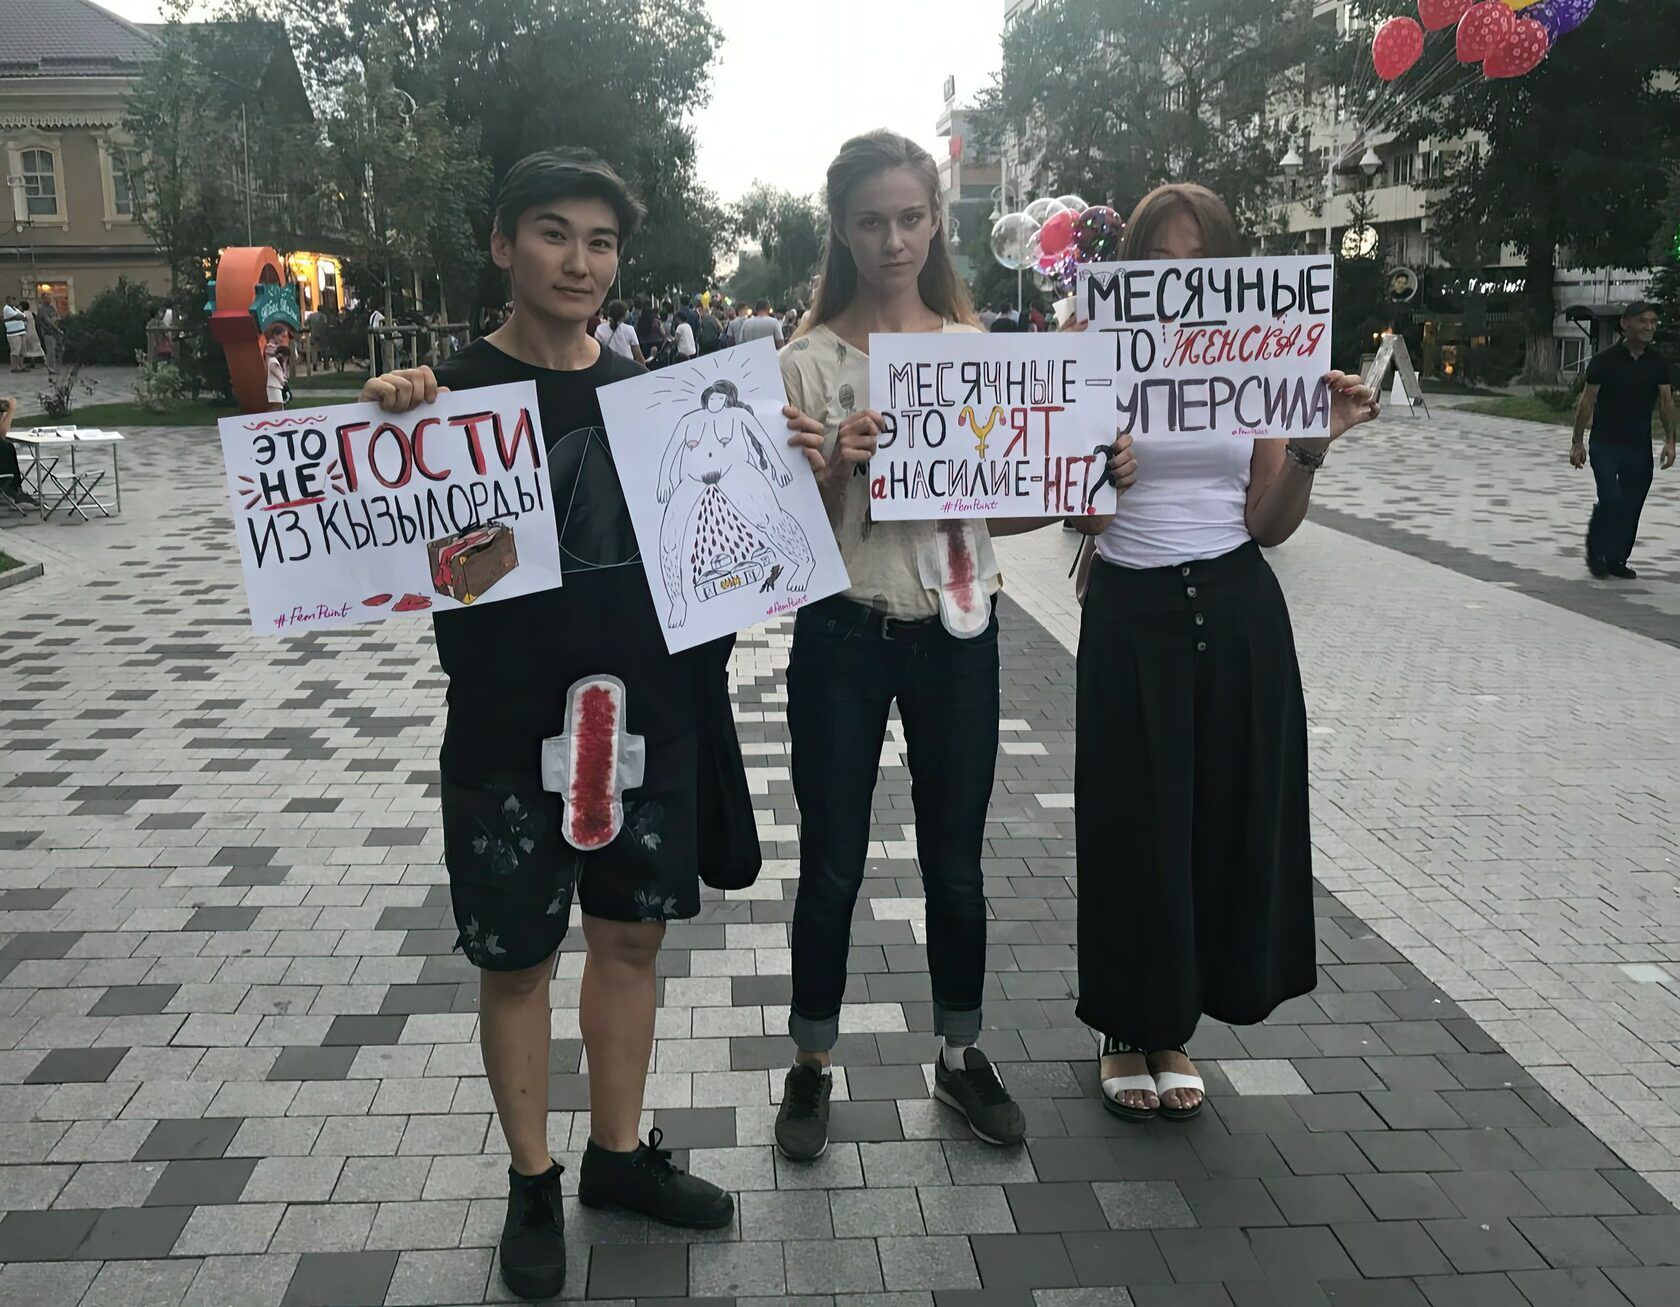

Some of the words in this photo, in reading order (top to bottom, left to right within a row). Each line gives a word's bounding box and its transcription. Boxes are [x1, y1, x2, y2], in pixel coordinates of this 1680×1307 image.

[1087, 264, 1332, 323] МЕСЯЧНЫЕ
[1099, 328, 1156, 373] ТО
[1163, 322, 1326, 369] ЖЕНСКАЯ
[888, 359, 1078, 409] МЕСЯЧНЫЕ
[1117, 375, 1330, 436] УПЕРСИЛА
[252, 428, 327, 466] ЭТО
[336, 407, 542, 493] ГОСТИ
[878, 408, 947, 449] ЭТО
[259, 462, 325, 506] НЕ
[247, 511, 312, 569] ИЗ
[316, 471, 545, 554] КЫЗЫЛОРДЫ
